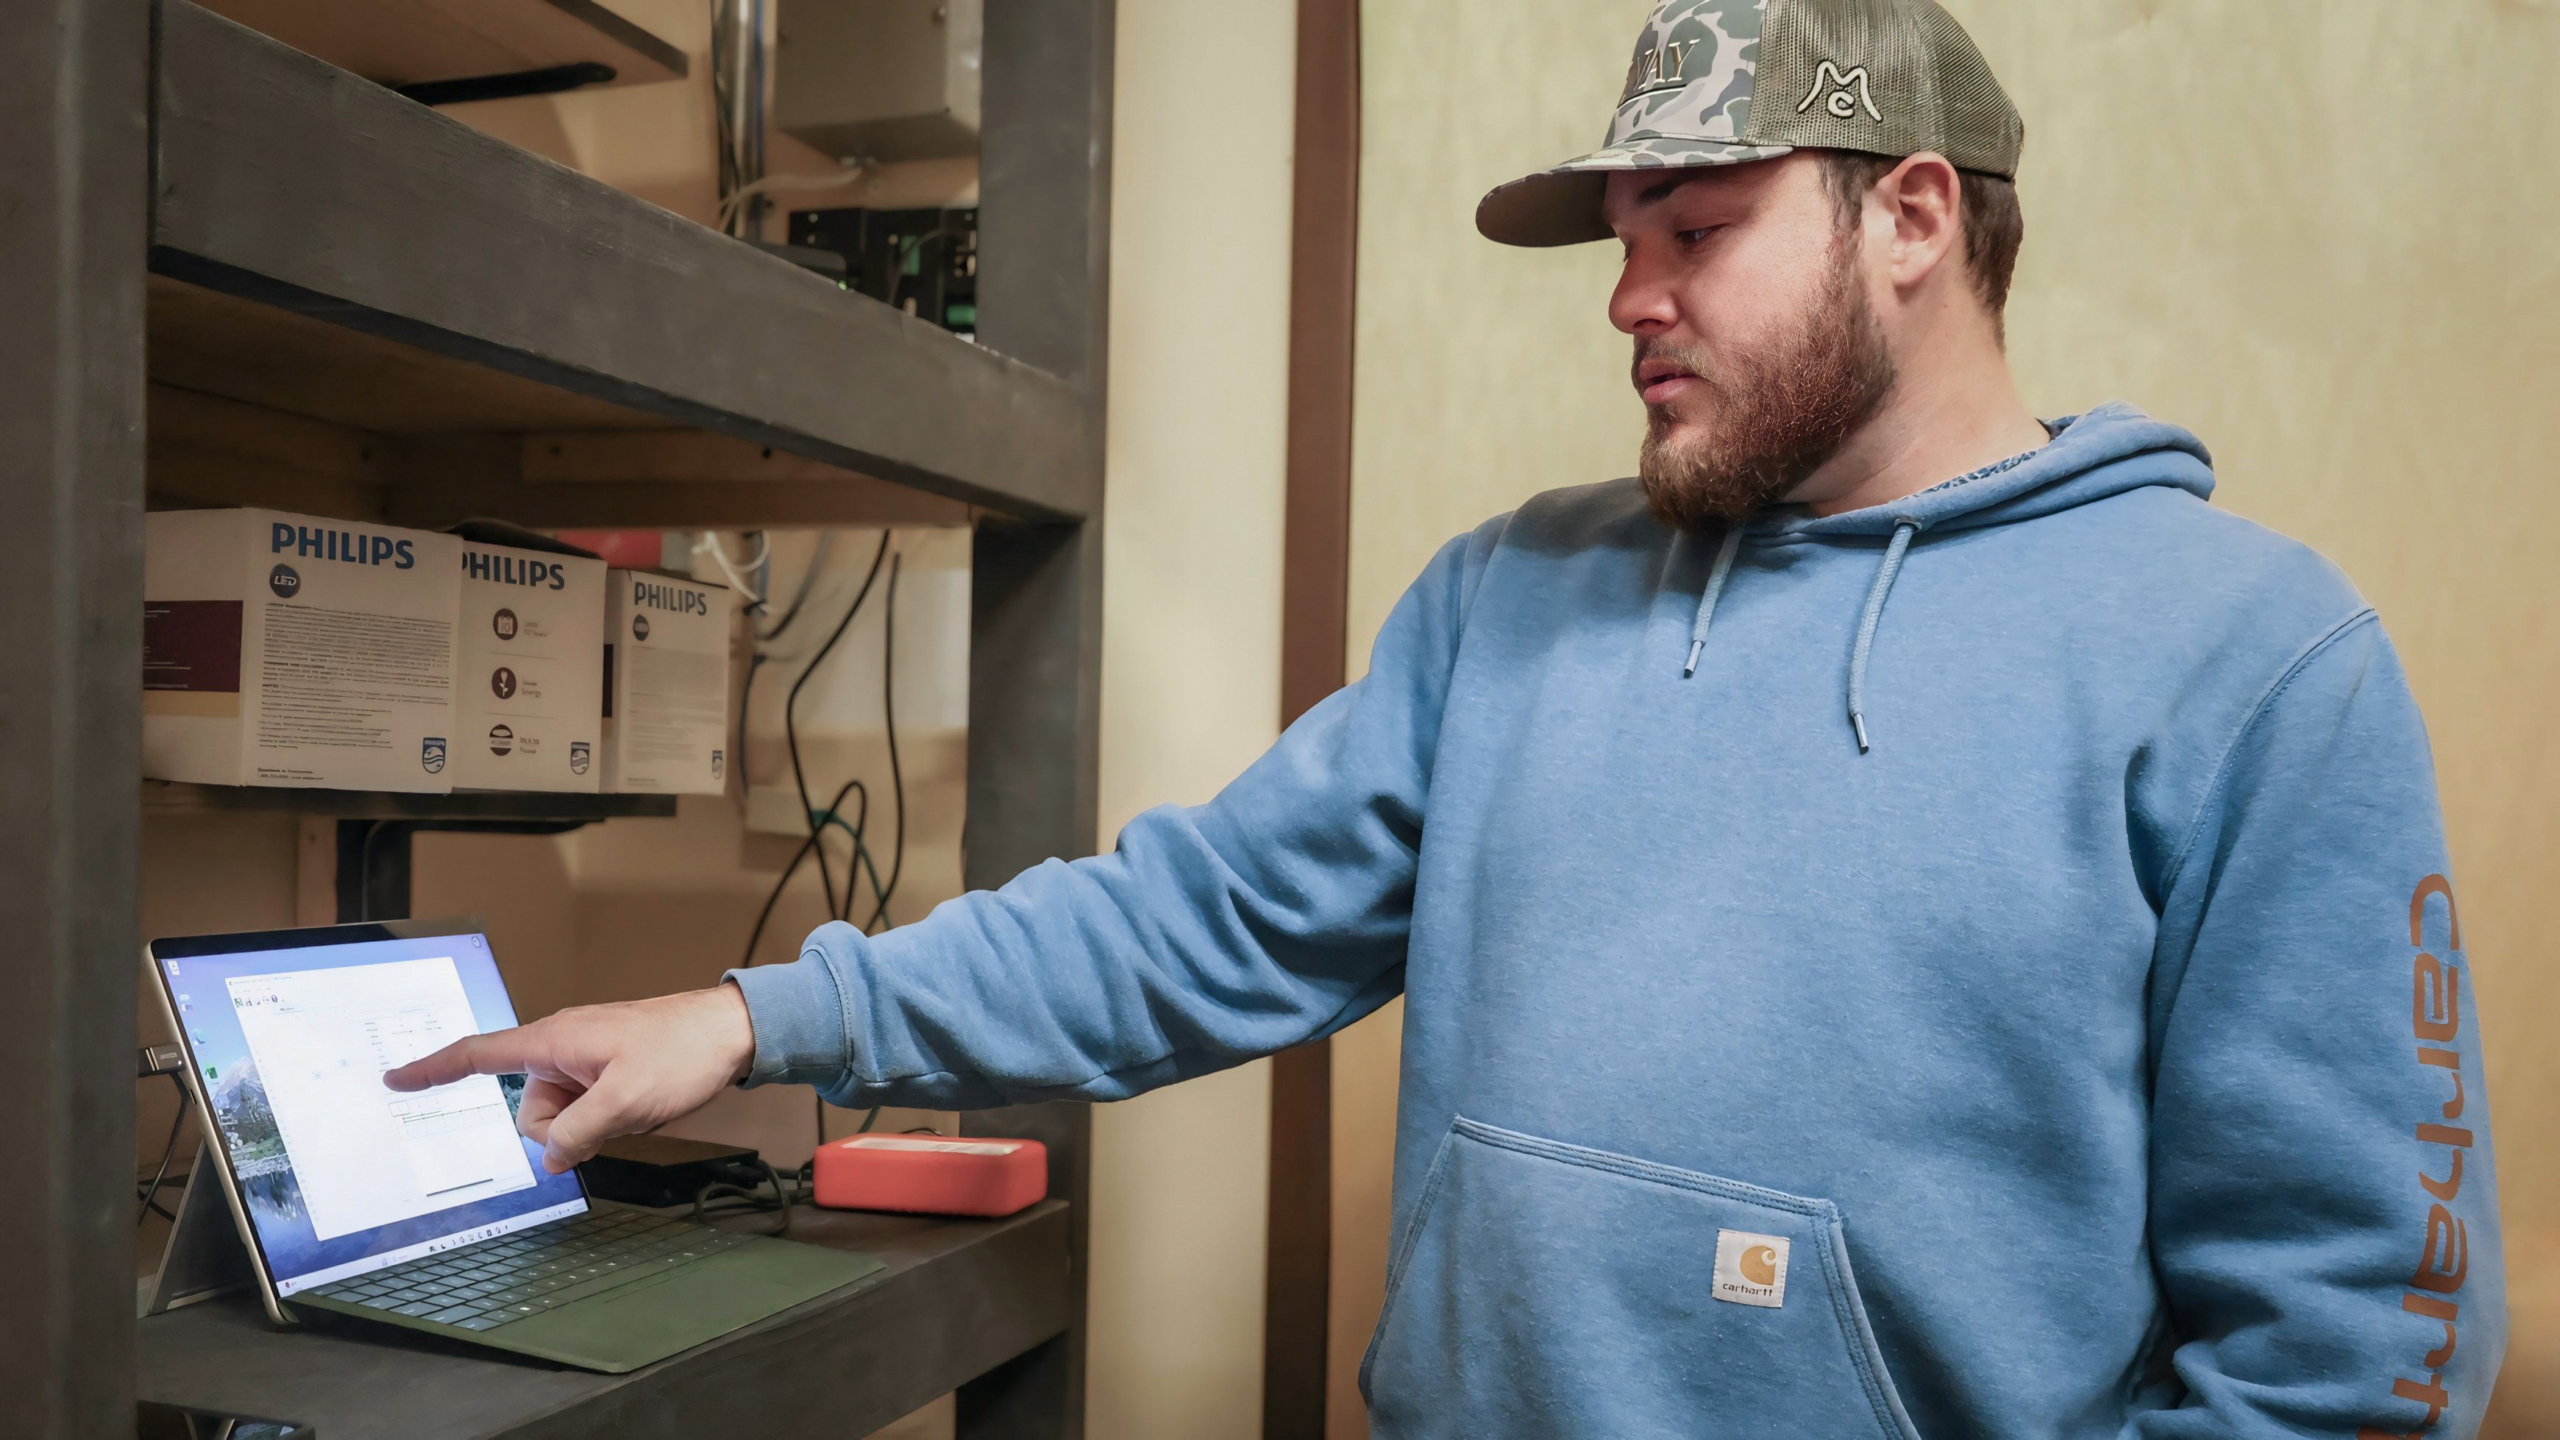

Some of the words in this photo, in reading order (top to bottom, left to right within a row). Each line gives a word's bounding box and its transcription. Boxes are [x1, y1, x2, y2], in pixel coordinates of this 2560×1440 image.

[271, 522, 415, 570] PHILIPS
[274, 574, 297, 587] LED
[634, 581, 708, 616] PHILIPS
[1722, 1283, 1773, 1296] carhartt
